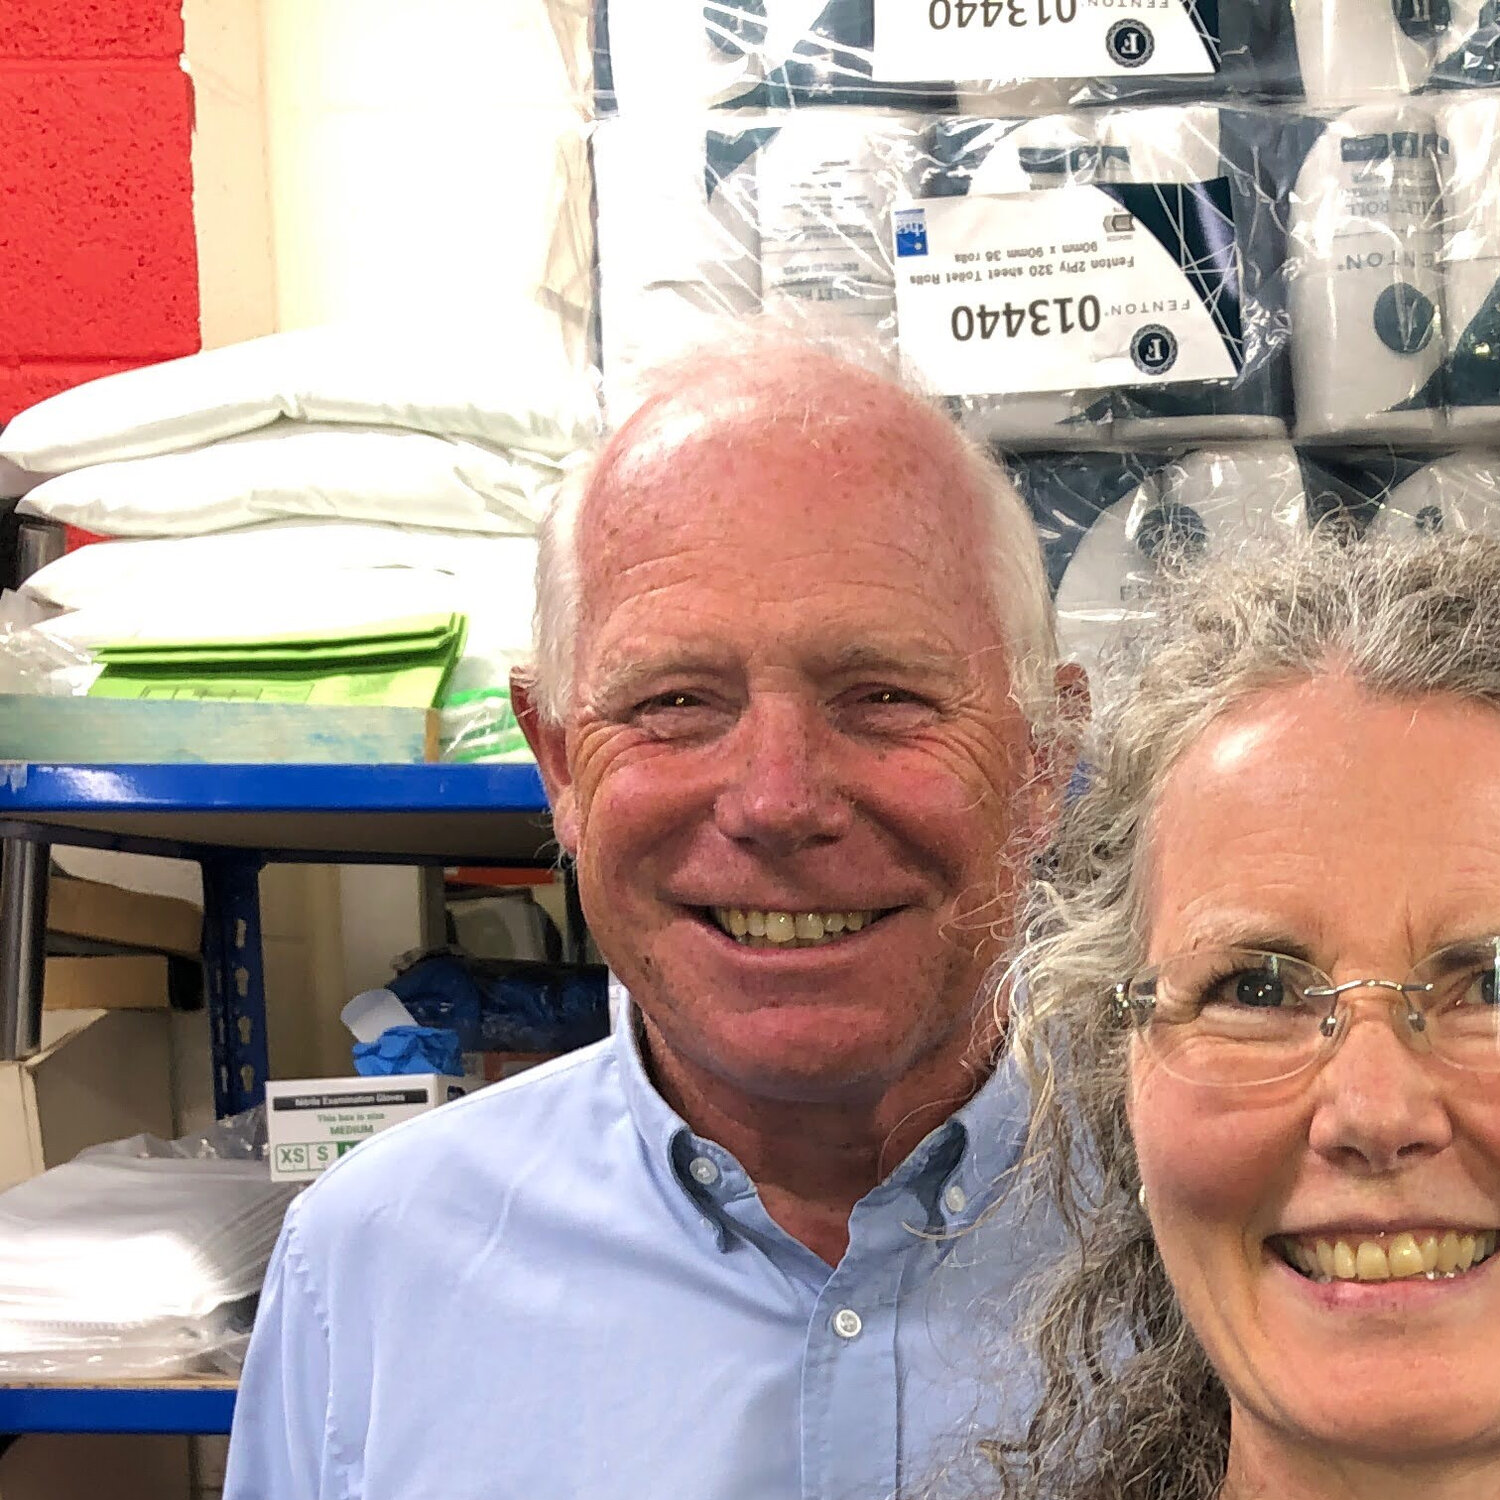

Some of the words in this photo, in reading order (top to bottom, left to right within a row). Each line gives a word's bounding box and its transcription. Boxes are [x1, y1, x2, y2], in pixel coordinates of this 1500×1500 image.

[929, 0, 1077, 30] 013440
[1006, 246, 1044, 259] 90mm
[1049, 245, 1057, 255] x
[1061, 241, 1098, 254] 90mm
[954, 252, 981, 264] rolls
[1090, 256, 1135, 269] Fenton
[988, 266, 1023, 280] sheet
[1028, 264, 1054, 278] 320
[1060, 260, 1086, 274] 2Ply
[909, 273, 941, 286] Rolls
[946, 271, 982, 284] Toilet
[1108, 299, 1191, 317] FENTON
[951, 294, 1101, 341] 013440
[329, 1124, 374, 1136] MEDIUM
[280, 1147, 305, 1165] XS
[316, 1145, 329, 1163] S
